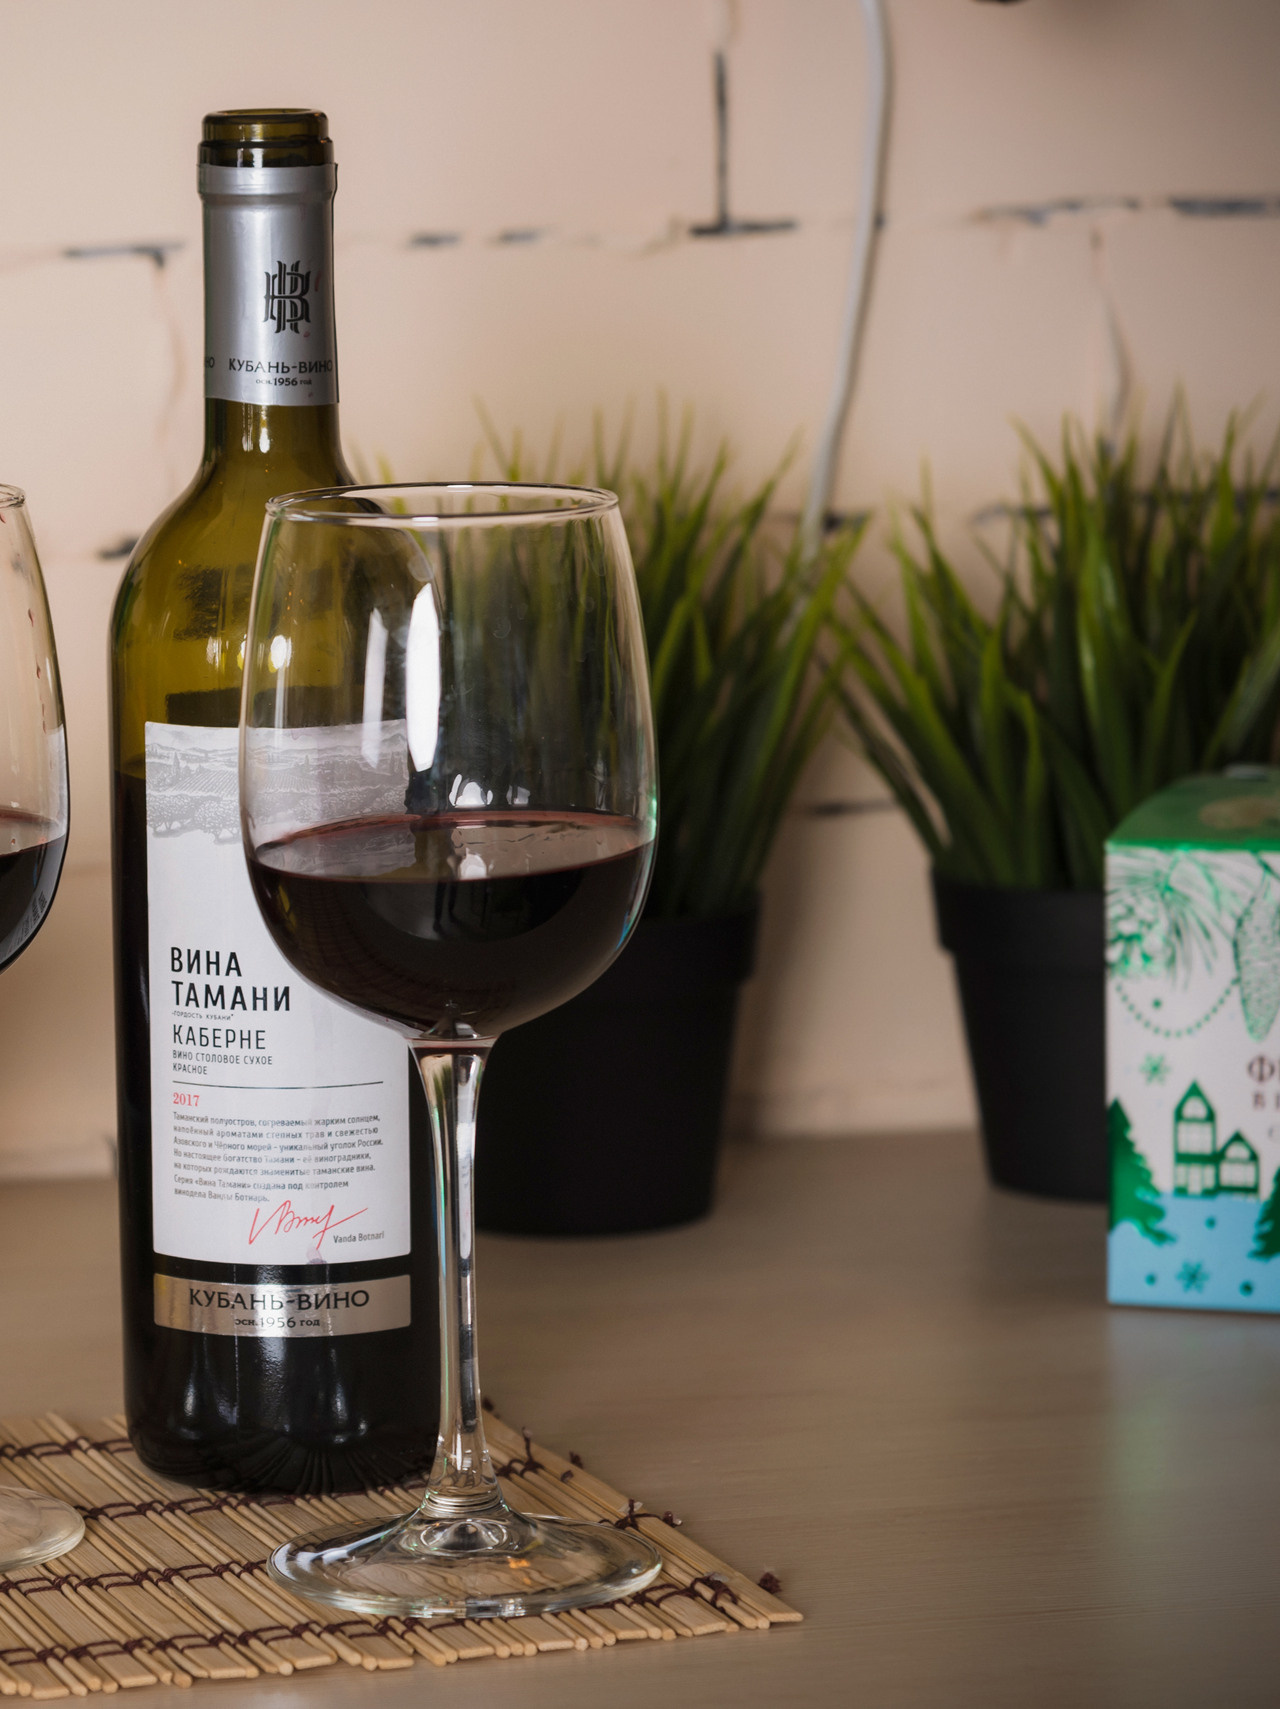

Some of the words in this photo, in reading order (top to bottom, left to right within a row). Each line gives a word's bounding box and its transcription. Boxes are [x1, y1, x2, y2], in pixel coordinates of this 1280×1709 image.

[228, 358, 333, 374] КУБАНЬ-ВИНО
[273, 376, 298, 387] 1956
[170, 946, 242, 977] ВИНА
[171, 980, 290, 1012] ТАМАНИ
[173, 1024, 266, 1050] КАБЕРНЕ
[172, 1049, 193, 1061] ВИНО
[195, 1052, 240, 1065] СТОЛОВОЕ
[243, 1055, 273, 1066] СУХОЕ
[172, 1062, 208, 1075] КРАСНОЕ
[173, 1092, 200, 1107] 2017
[173, 1112, 209, 1123] Таманский
[210, 1117, 257, 1128] полуостров,
[314, 1117, 346, 1127] жарким
[347, 1114, 381, 1125] солнцем,
[216, 1130, 263, 1139] ароматами
[266, 1131, 302, 1139] степных
[305, 1131, 325, 1140] трав
[327, 1130, 333, 1138] и
[334, 1127, 379, 1138] свежестью
[173, 1136, 207, 1148] Азовского
[246, 1143, 272, 1152] морей
[330, 1141, 356, 1152] уголок
[357, 1138, 384, 1148] России.
[173, 1148, 182, 1157] Но
[183, 1151, 222, 1162] настоящее
[223, 1154, 263, 1163] богатство
[314, 1152, 372, 1163] виноградники,
[173, 1162, 182, 1170] на
[183, 1163, 212, 1173] которых
[213, 1166, 258, 1176] рождаются
[260, 1167, 311, 1176] знаменитые
[312, 1165, 355, 1176] таманские
[356, 1164, 376, 1173] вина.
[173, 1174, 193, 1185] Серия
[287, 1182, 303, 1191] под
[174, 1187, 207, 1199] винодела
[333, 1233, 357, 1244] Vanda
[358, 1230, 385, 1242] Botnari
[189, 1287, 370, 1311] КУБАНЬ-ВИНО
[259, 1317, 297, 1329] 1956
[299, 1318, 321, 1328] год
